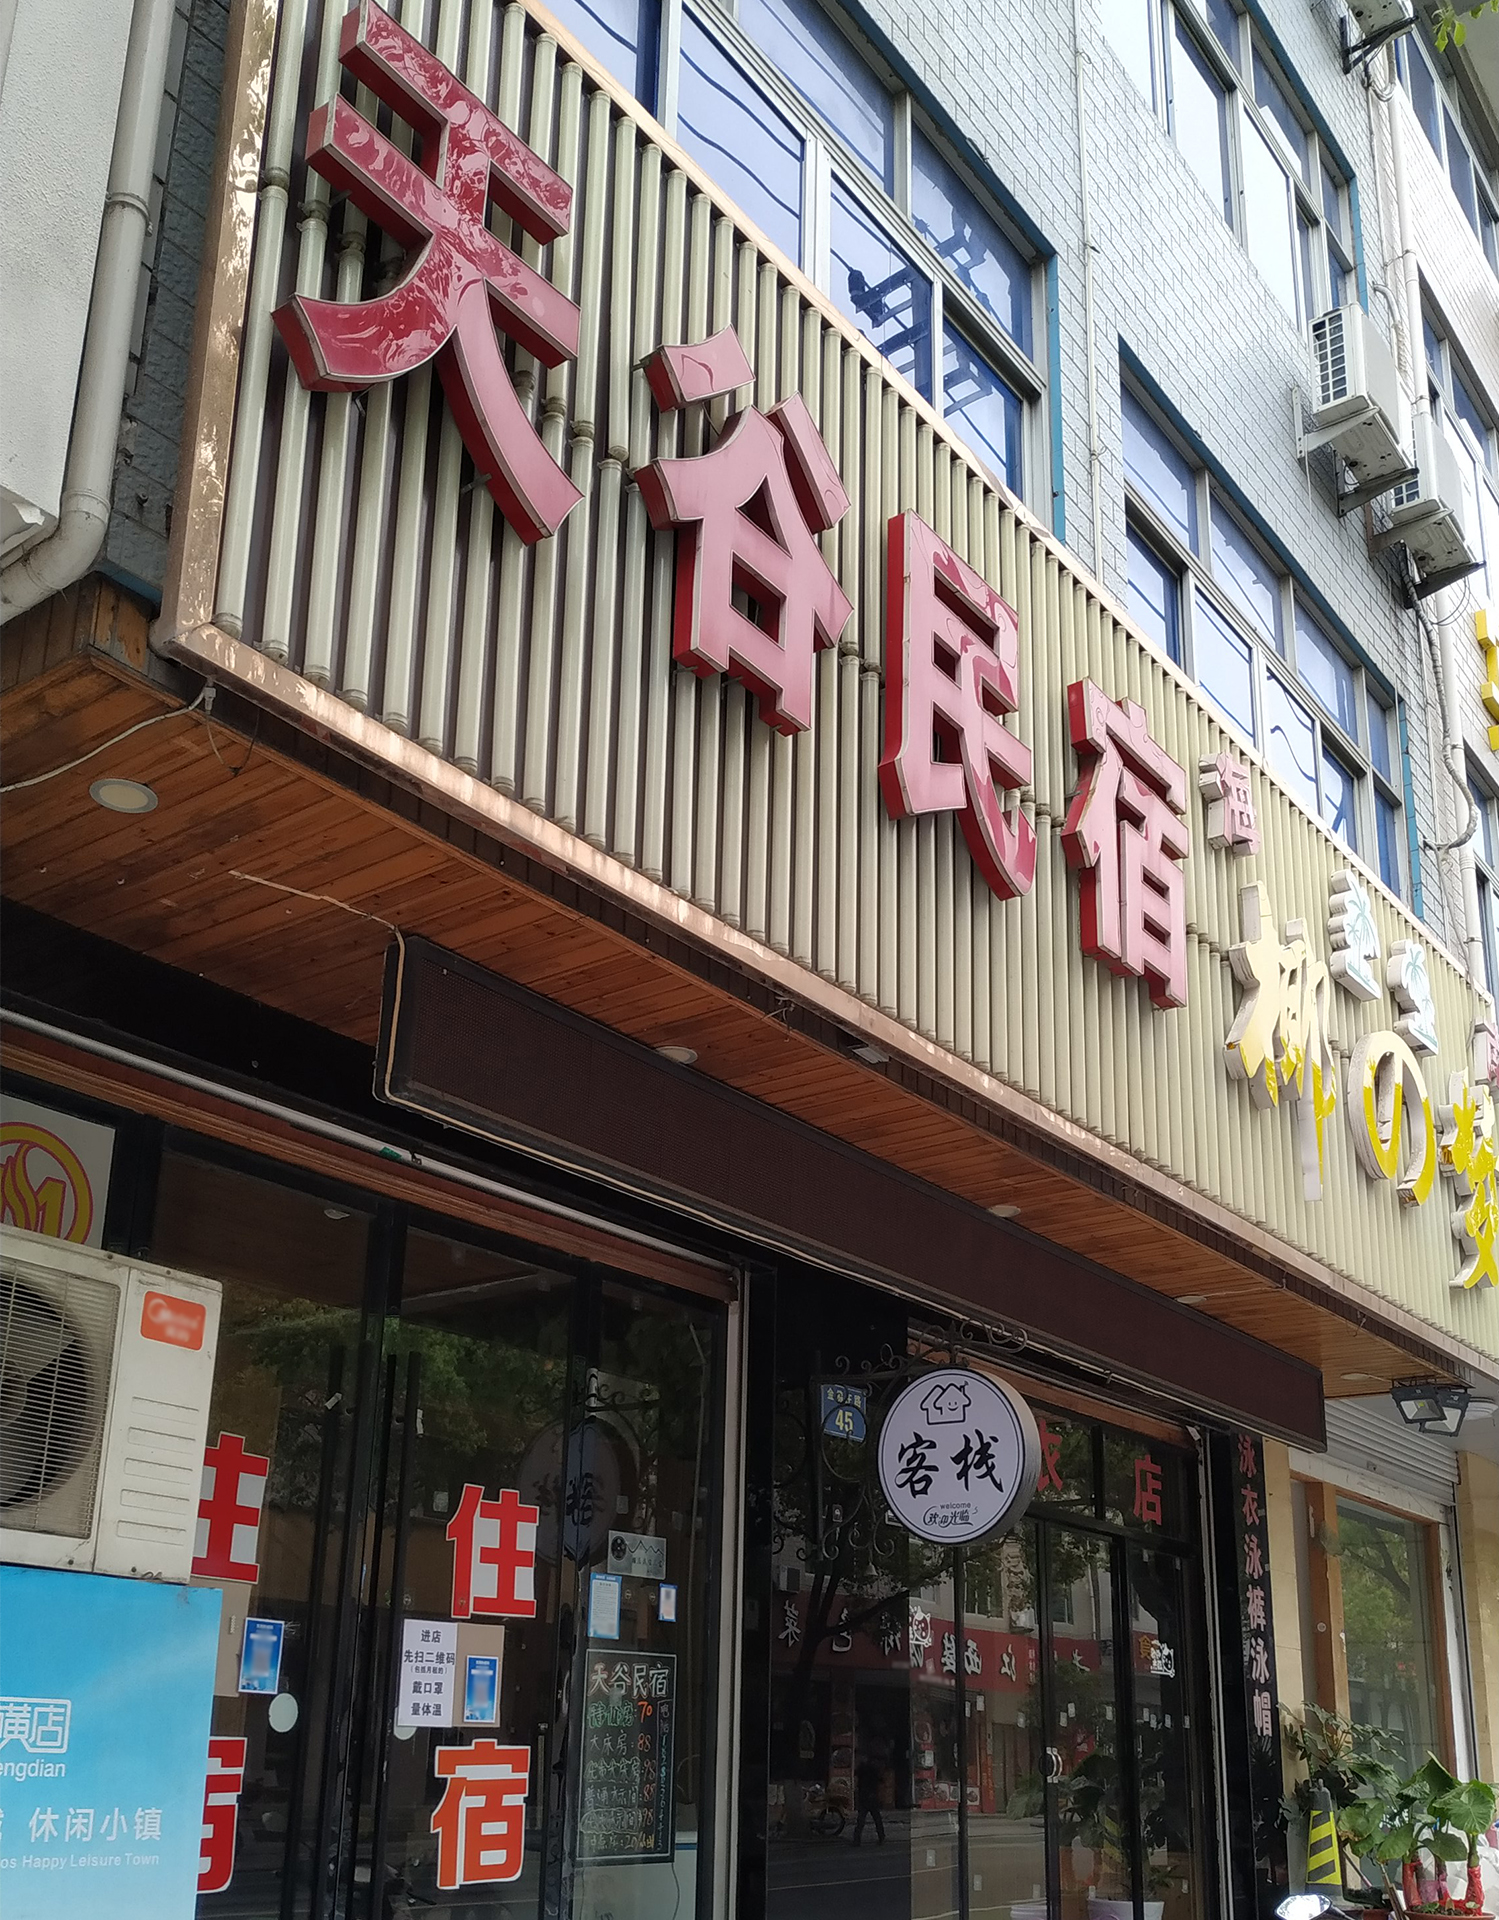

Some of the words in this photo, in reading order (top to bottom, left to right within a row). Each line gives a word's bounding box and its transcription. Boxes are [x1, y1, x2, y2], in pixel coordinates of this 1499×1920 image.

[273, 0, 1190, 1010] 天谷民宿
[835, 1409, 853, 1432] 45
[895, 1428, 1004, 1499] 客栈
[923, 1507, 974, 1528] 欢迎光临
[940, 1502, 971, 1511] welcome
[1238, 1434, 1272, 1737] 泳衣泳裤泳帽
[420, 1629, 442, 1643] 进店
[403, 1648, 456, 1666] 先扫二维码
[412, 1681, 444, 1695] 戴口罩
[430, 1483, 540, 1890] 住宿
[587, 1661, 671, 1699] 天谷民宿
[411, 1702, 442, 1717] 量体温
[29, 1807, 163, 1842] 休闲小镇
[22, 1855, 67, 1871] Happy
[70, 1853, 121, 1867] Leisure
[125, 1852, 160, 1865] Town
